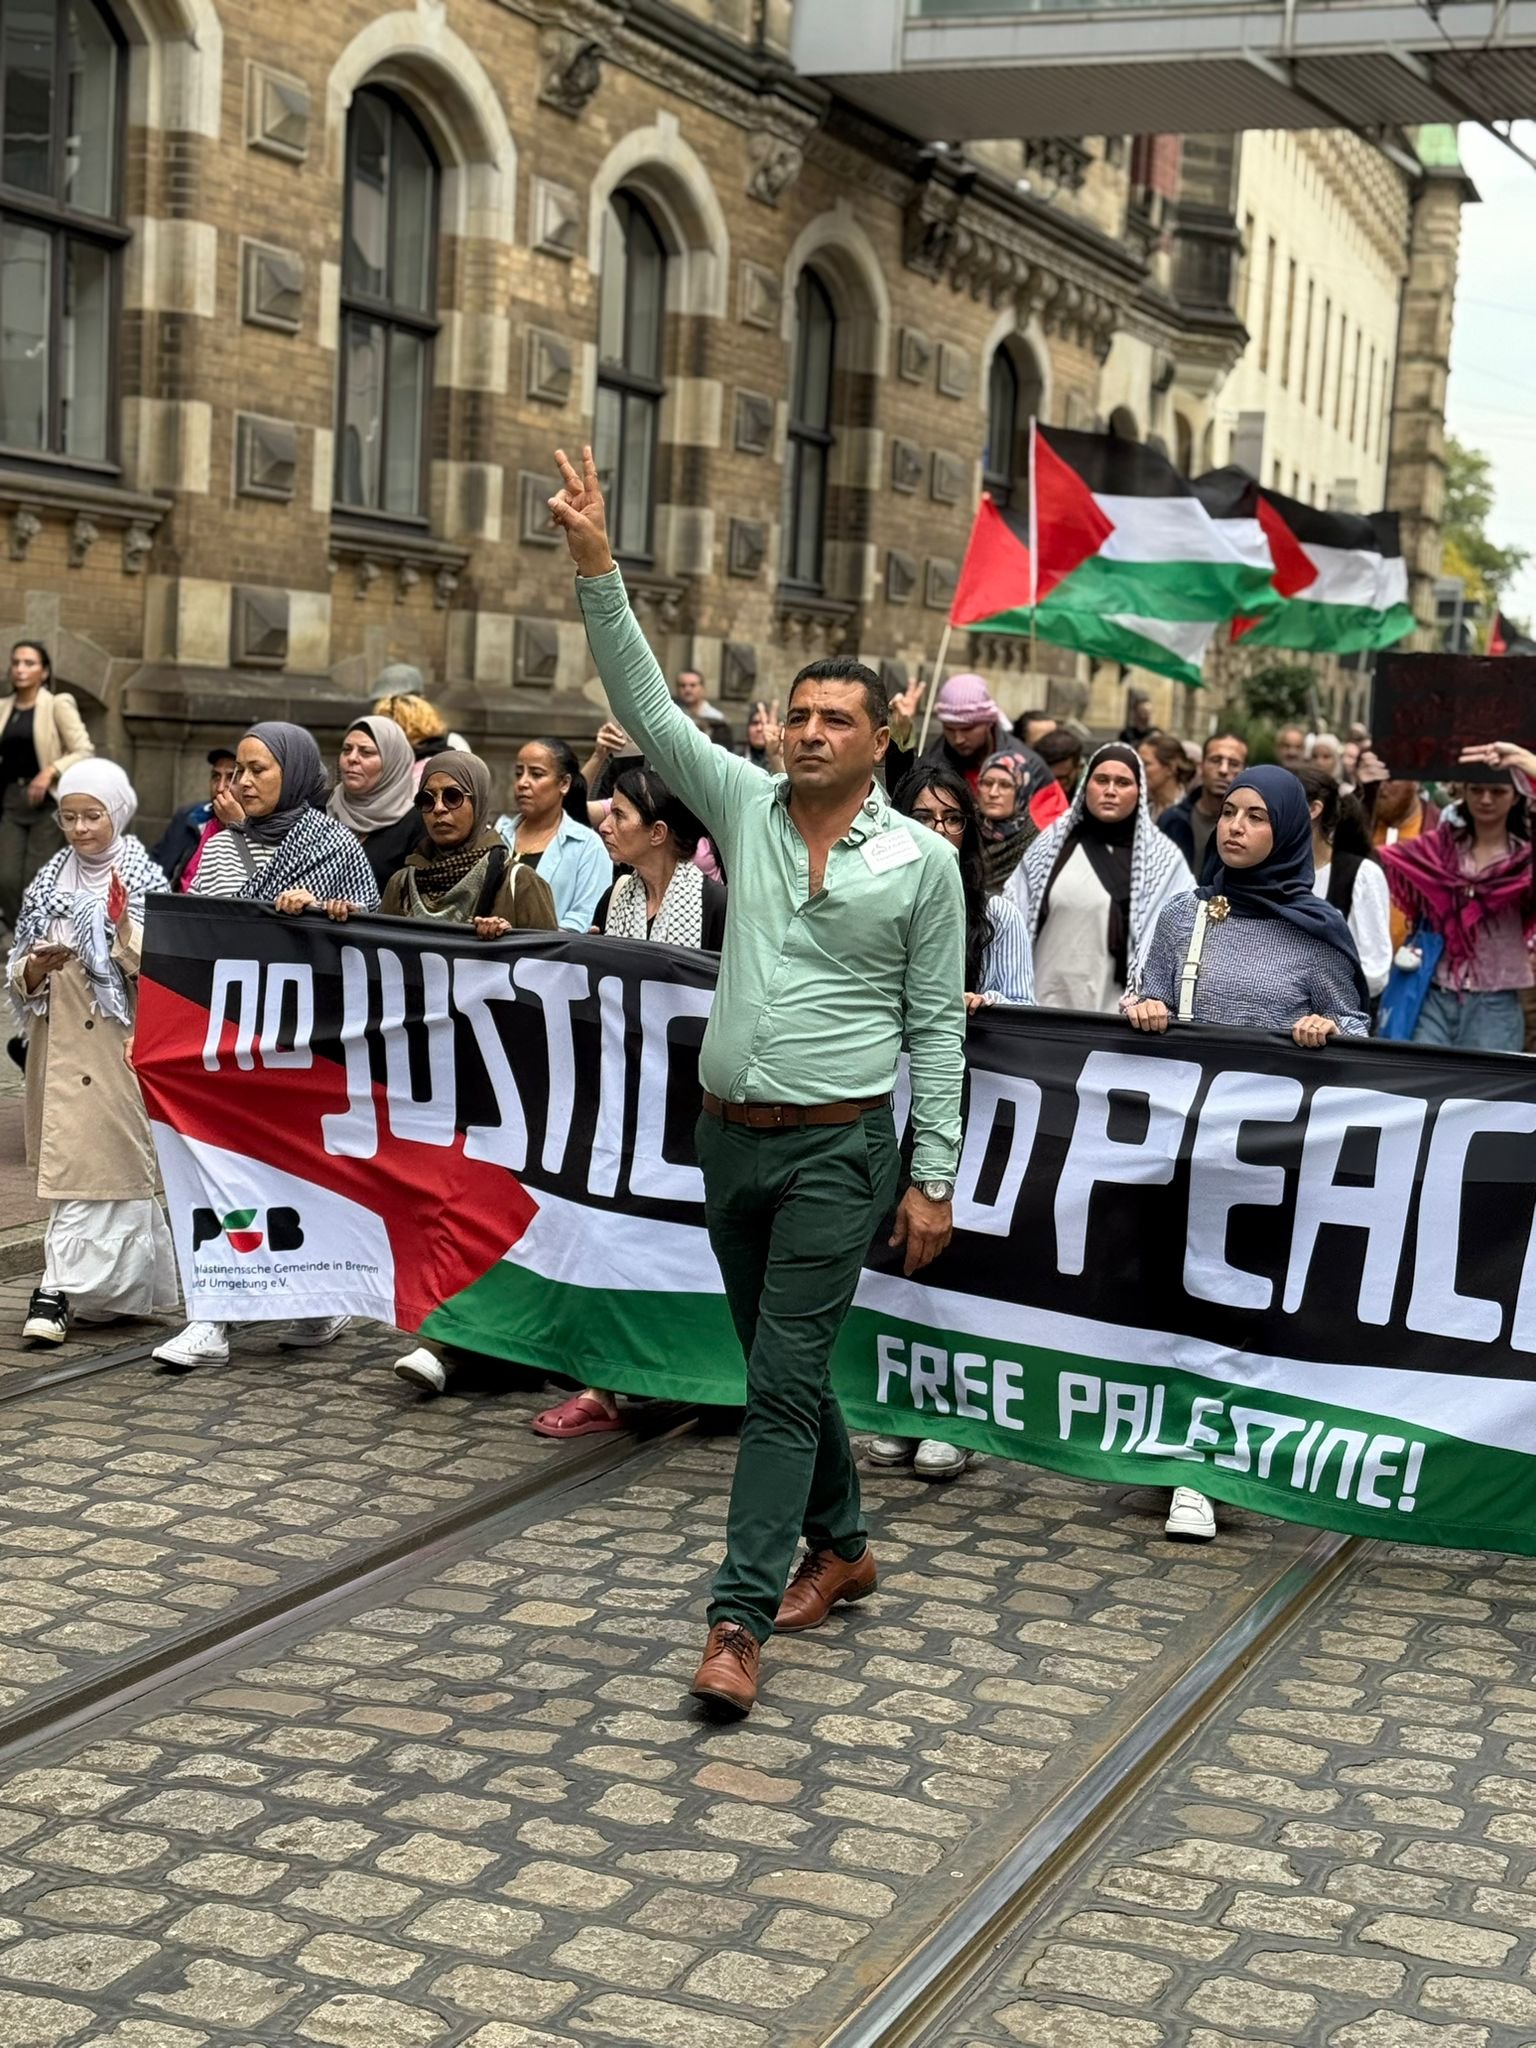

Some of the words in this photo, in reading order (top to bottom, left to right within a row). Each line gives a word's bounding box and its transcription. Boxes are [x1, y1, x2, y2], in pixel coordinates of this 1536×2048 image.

[320, 946, 716, 1202] JUSTIC
[194, 1264, 271, 1274] lästinenssche
[274, 1262, 330, 1273] Gemeinde
[333, 1261, 342, 1270] in
[345, 1261, 379, 1274] Bremen
[209, 1278, 267, 1290] Umgebung
[270, 1277, 289, 1288] e.V.
[877, 1334, 1024, 1430] FREE
[1058, 1371, 1425, 1512] PALESTINE!
